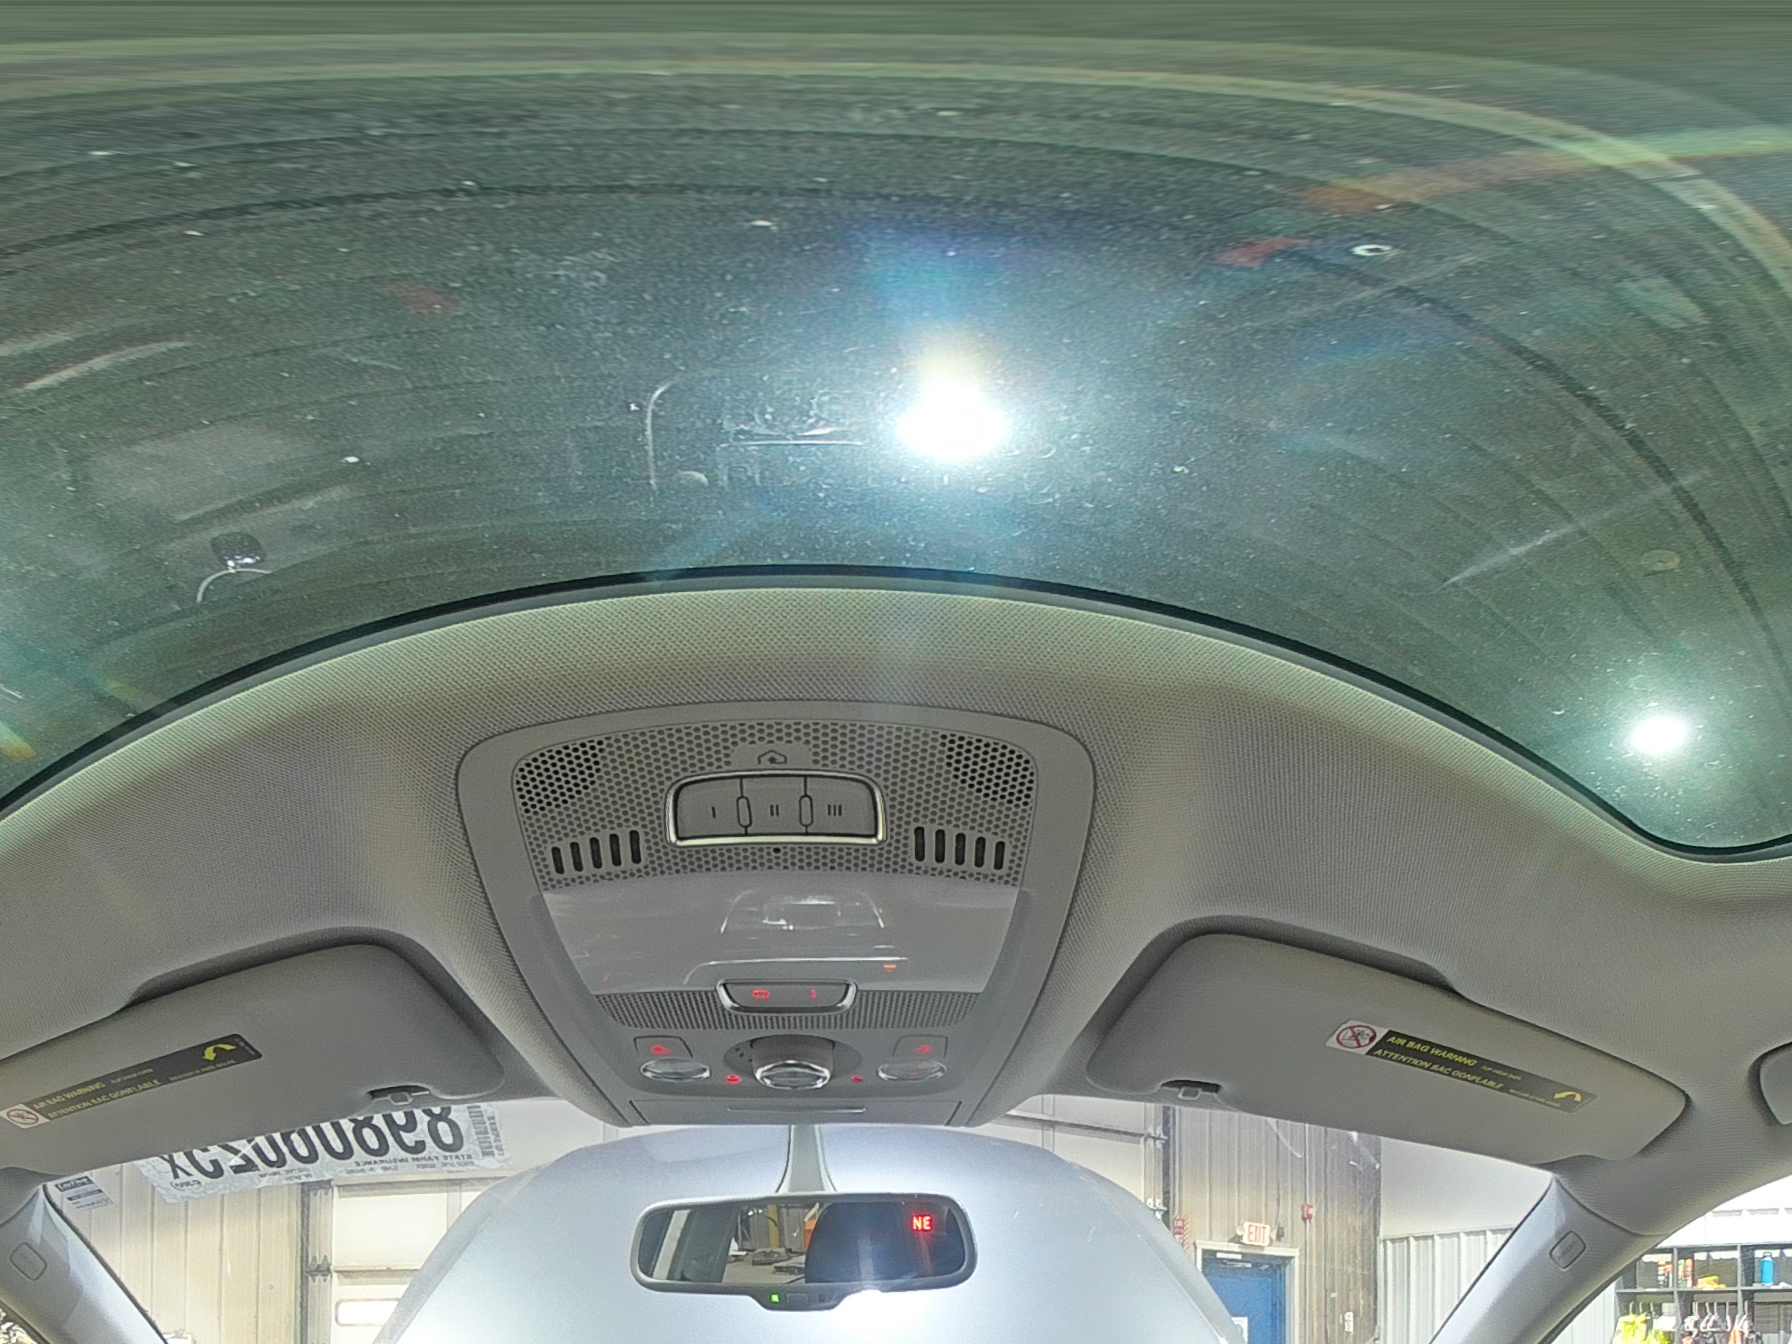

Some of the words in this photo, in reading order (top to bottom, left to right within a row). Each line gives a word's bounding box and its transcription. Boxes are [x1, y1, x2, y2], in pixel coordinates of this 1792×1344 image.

[1373, 1048, 1432, 1069] ATTENTION
[1387, 1036, 1407, 1046] AIR
[1407, 1041, 1429, 1053] BAG
[1430, 1048, 1478, 1067] WARNING
[63, 1082, 107, 1099] WARNING
[48, 1100, 92, 1118] ATTENTION
[913, 1216, 932, 1230] NE
[1248, 1224, 1268, 1244] EXIT
